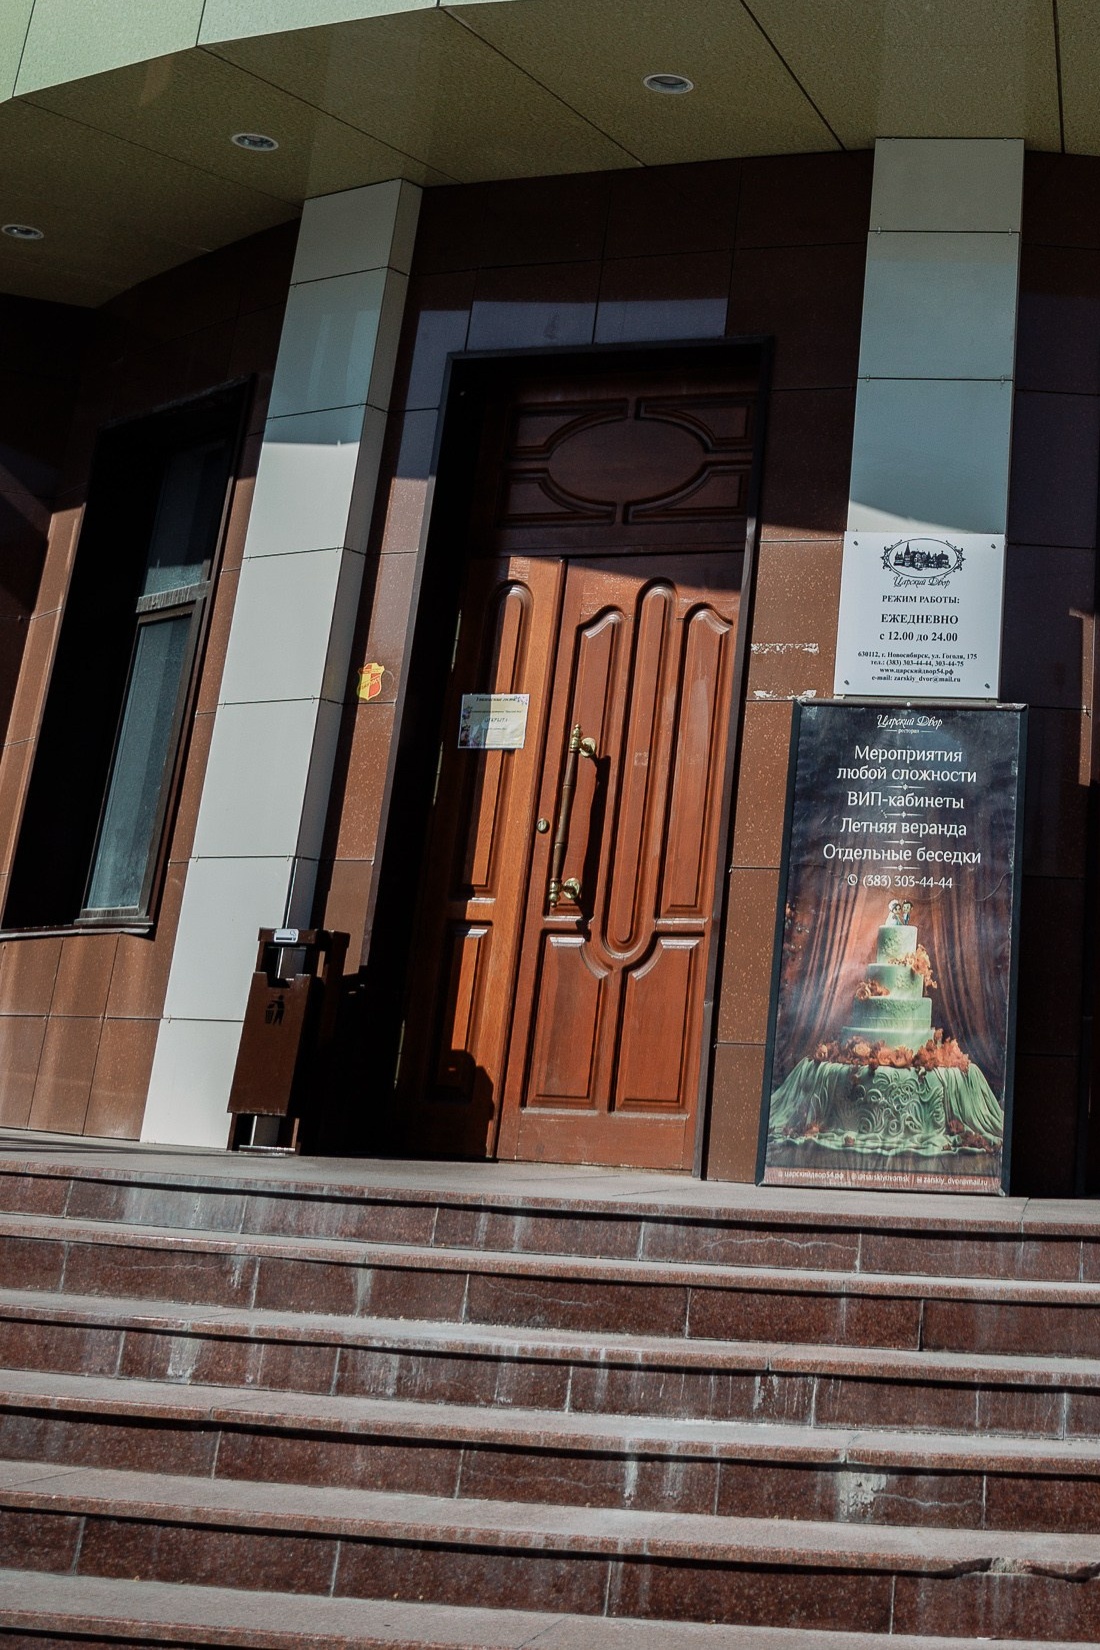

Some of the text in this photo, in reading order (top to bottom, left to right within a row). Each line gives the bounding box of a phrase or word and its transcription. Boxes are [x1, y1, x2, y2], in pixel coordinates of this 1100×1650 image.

[893, 576, 951, 588] Царский Двор
[881, 594, 960, 604] РЕЖИМ РАБОТЫ:
[880, 613, 959, 625] ЕЖЕДНЕВНО
[879, 631, 958, 643] с 12.00 до 24.00
[857, 651, 881, 659] 630112,
[887, 652, 930, 660] Новосибирск,
[877, 714, 943, 730] Царский Двор
[854, 745, 963, 763] Мероприятия
[837, 767, 977, 783] любой сложности
[847, 791, 965, 810] ВИП-кабинеты
[840, 818, 967, 837] Летняя веранда
[823, 843, 982, 865] Отдельные беседки
[862, 875, 953, 889] (383) 303-44-44
